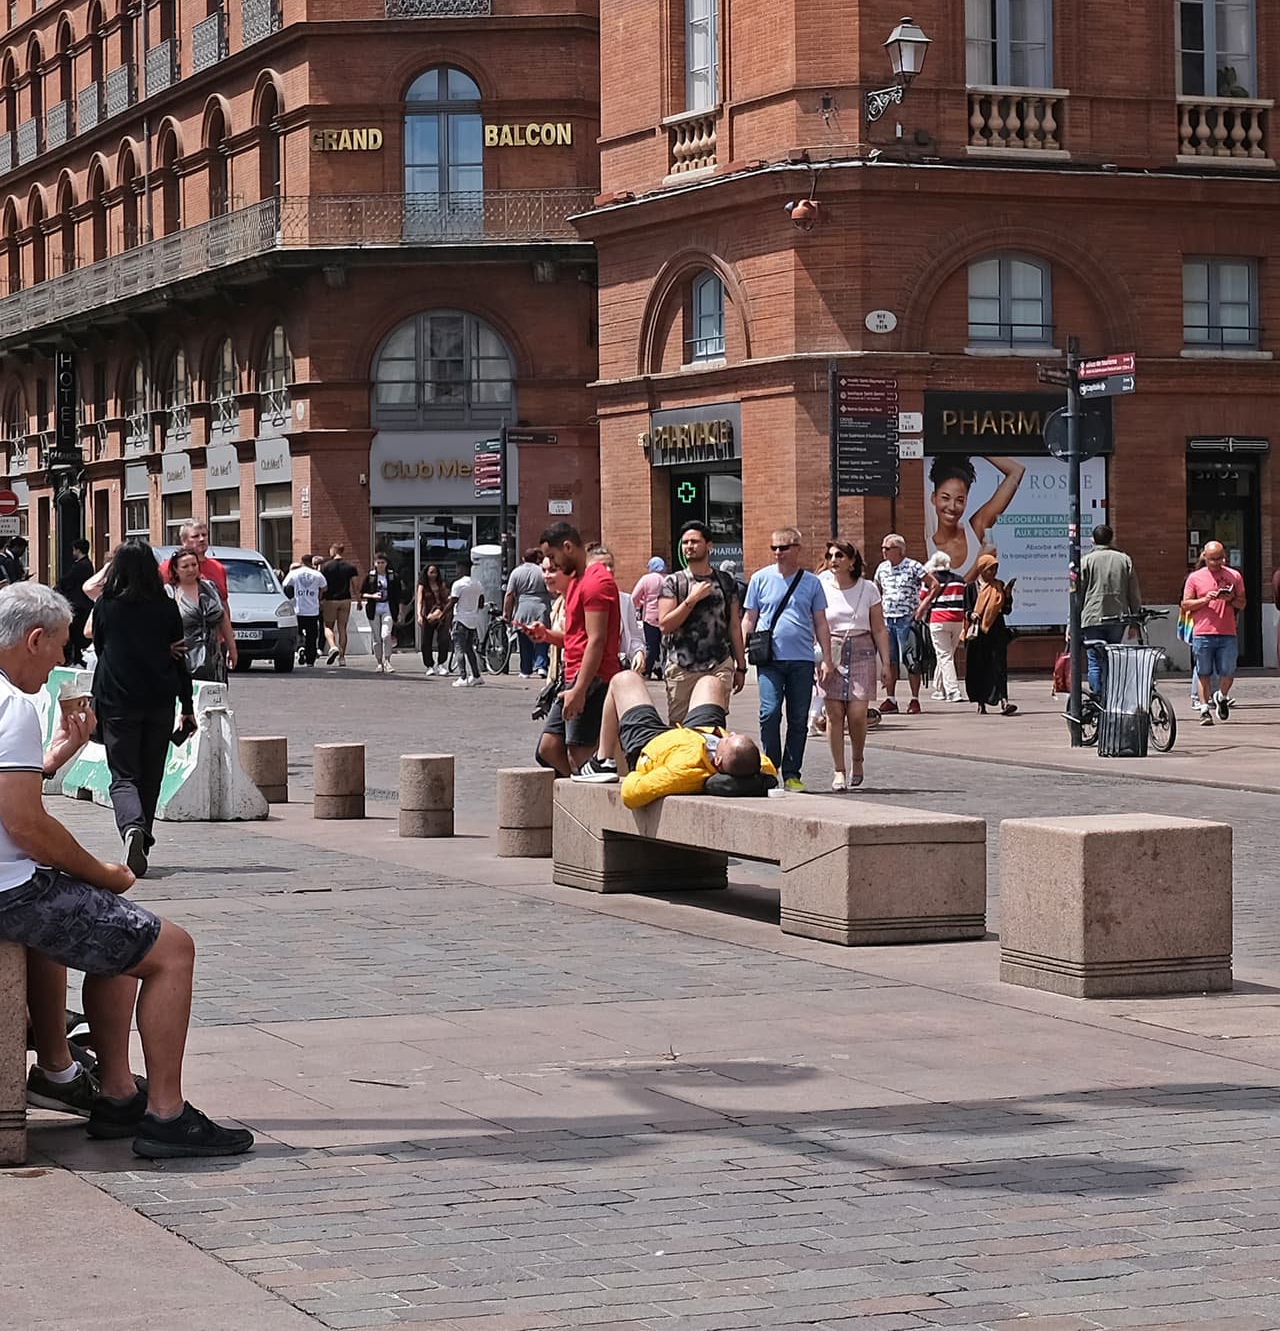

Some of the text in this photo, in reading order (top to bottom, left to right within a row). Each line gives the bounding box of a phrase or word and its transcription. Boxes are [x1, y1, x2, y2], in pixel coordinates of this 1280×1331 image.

[311, 124, 571, 150] GRAND BALCON
[60, 352, 72, 438] HOTEL
[942, 410, 1043, 435] PHARM
[381, 459, 473, 479] Club Me
[1030, 475, 1093, 489] ROSE
[1034, 529, 1092, 537] PROBIOTES
[710, 548, 743, 556] PHARMA
